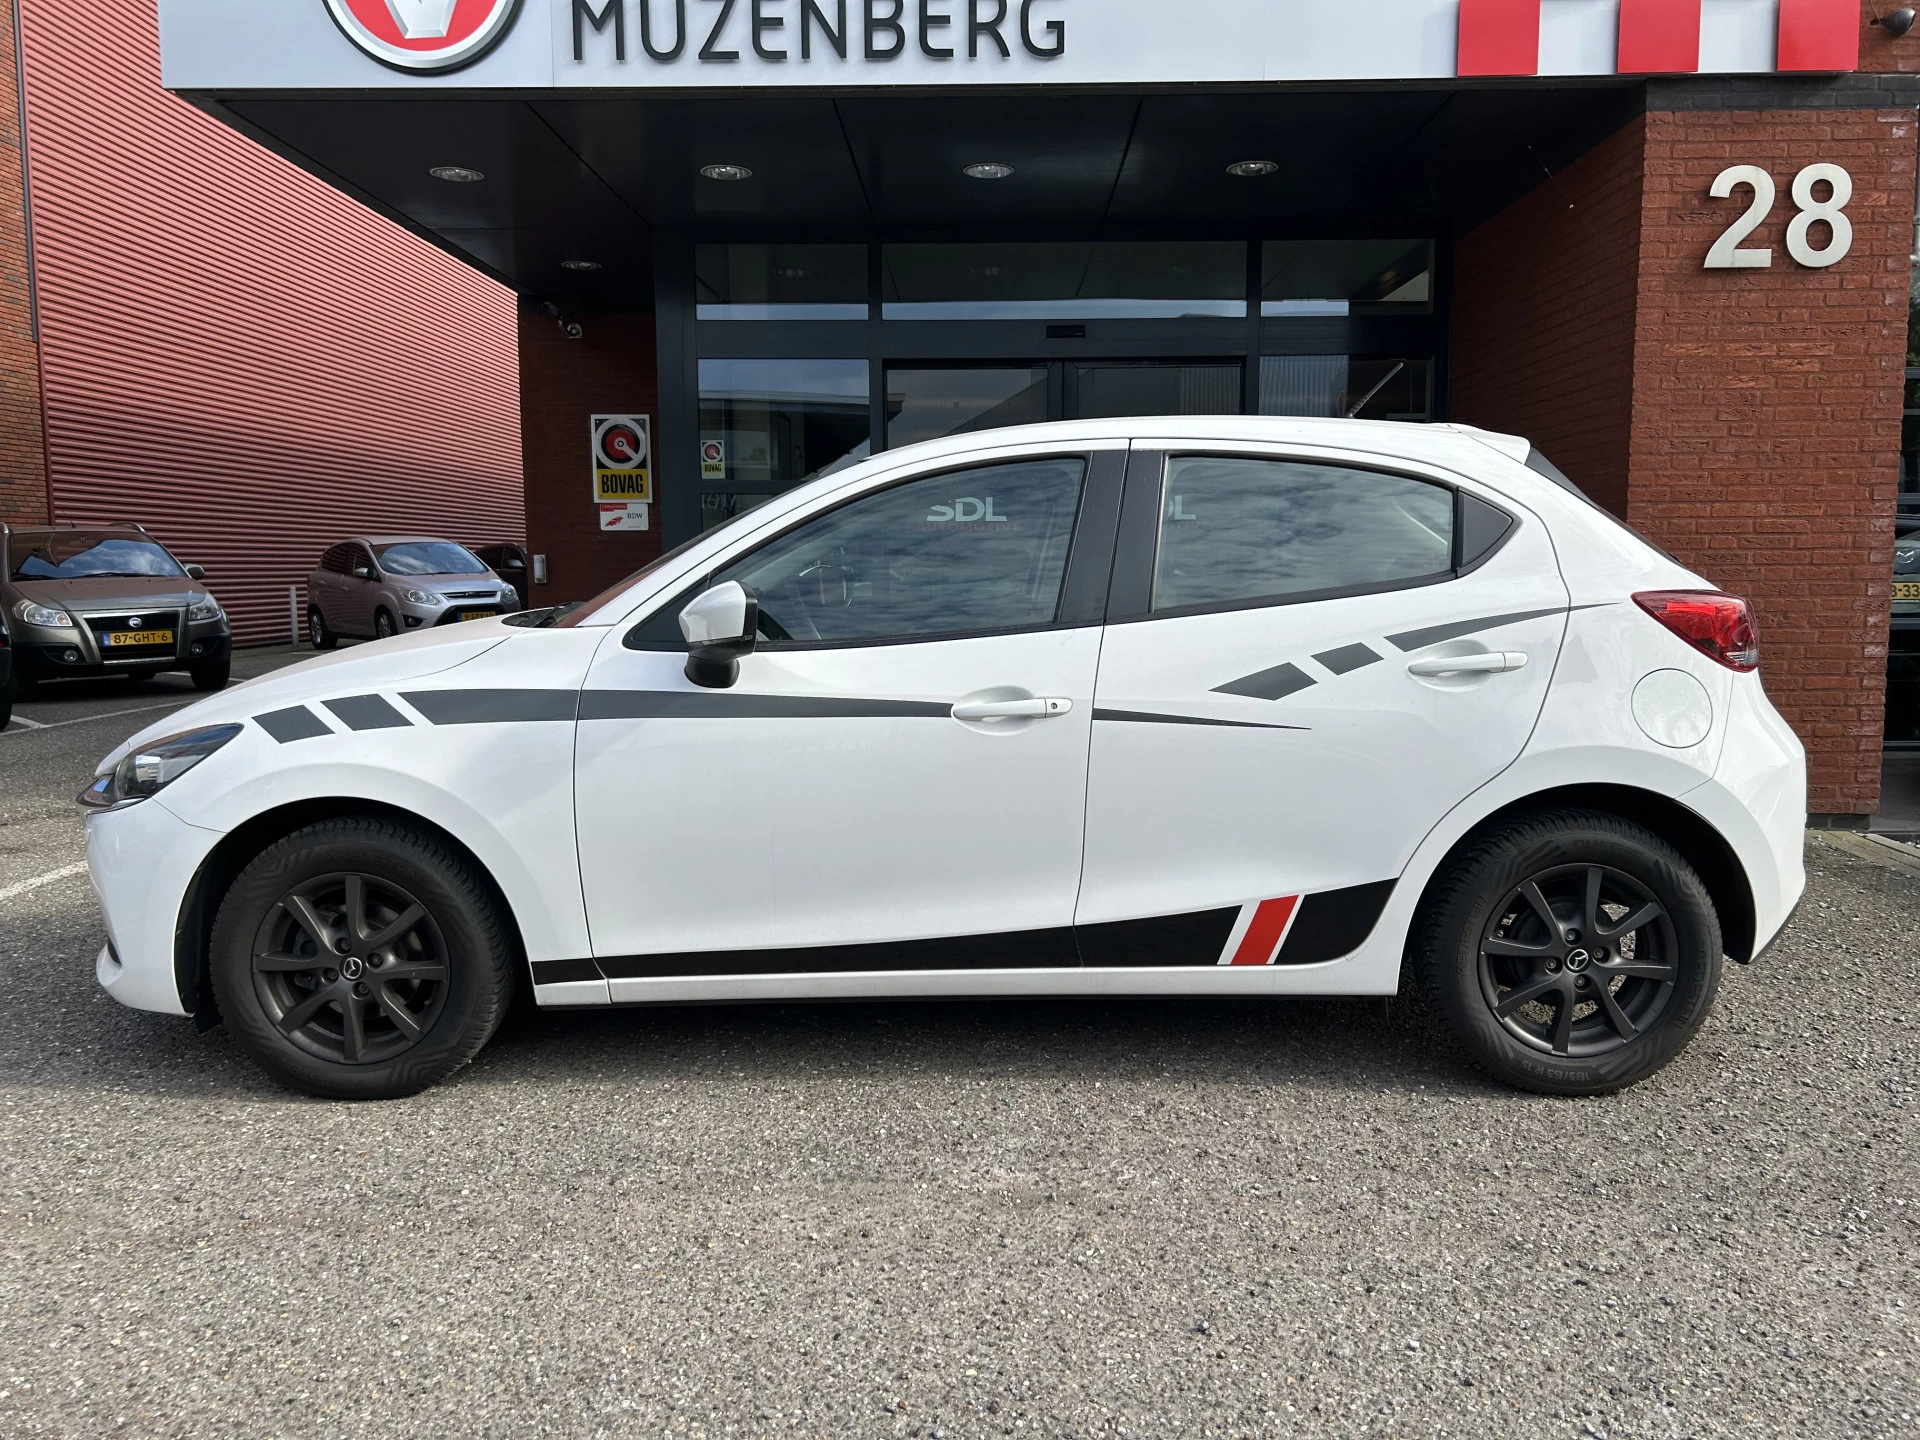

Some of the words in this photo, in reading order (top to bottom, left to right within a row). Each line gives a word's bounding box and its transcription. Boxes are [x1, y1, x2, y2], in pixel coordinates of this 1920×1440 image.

[572, 0, 1066, 61] MUZENBERG
[1703, 162, 1853, 269] 28
[704, 463, 722, 473] BOVAG
[601, 473, 644, 494] BOVAG
[926, 496, 1008, 522] SDL
[627, 512, 643, 520] RDW
[914, 521, 1023, 533] AUTOMOTIVE
[113, 632, 168, 644] 87-GHT-6
[1546, 1068, 1591, 1081] 185/65
